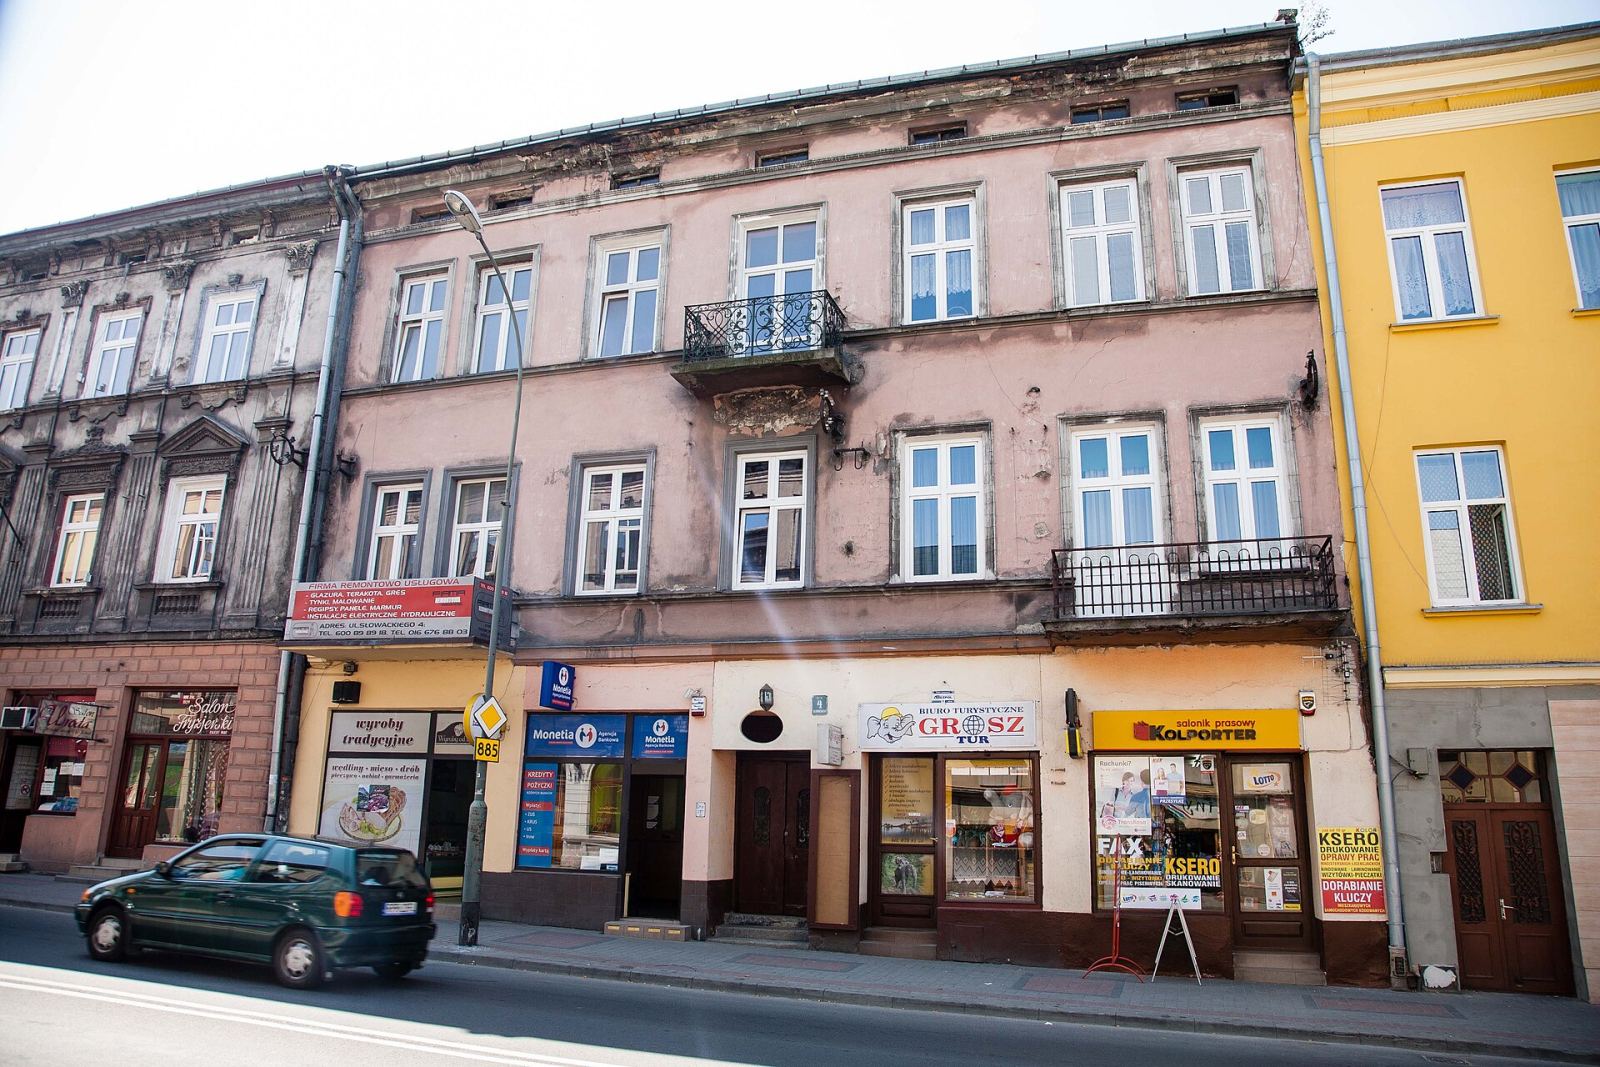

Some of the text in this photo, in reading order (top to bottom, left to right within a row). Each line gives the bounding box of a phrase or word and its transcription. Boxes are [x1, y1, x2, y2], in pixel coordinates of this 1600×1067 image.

[340, 581, 402, 589] REMONTOWO
[400, 610, 457, 618] HYDRAULICZNE
[552, 683, 571, 695] Monetia
[188, 697, 235, 714] Salon
[816, 700, 823, 709] 4
[919, 706, 1024, 715] BIURO TURYSTYCZNE
[356, 718, 404, 731] wyroby
[1176, 719, 1256, 730] salonik prasowy
[533, 729, 574, 740] Monetia
[1149, 725, 1257, 741] KOLPORTER
[342, 734, 414, 748] tradycyjne
[956, 736, 990, 744] TUR
[477, 742, 498, 758] 885
[400, 765, 420, 773] drób
[1253, 774, 1275, 785] LOTTO
[1319, 832, 1379, 846] KSERO
[1320, 853, 1380, 861] OPRAWY PRAC
[1165, 857, 1220, 875] KSERO
[1322, 881, 1383, 891] DORABIANIE
[1334, 892, 1372, 903] KLUCZY
